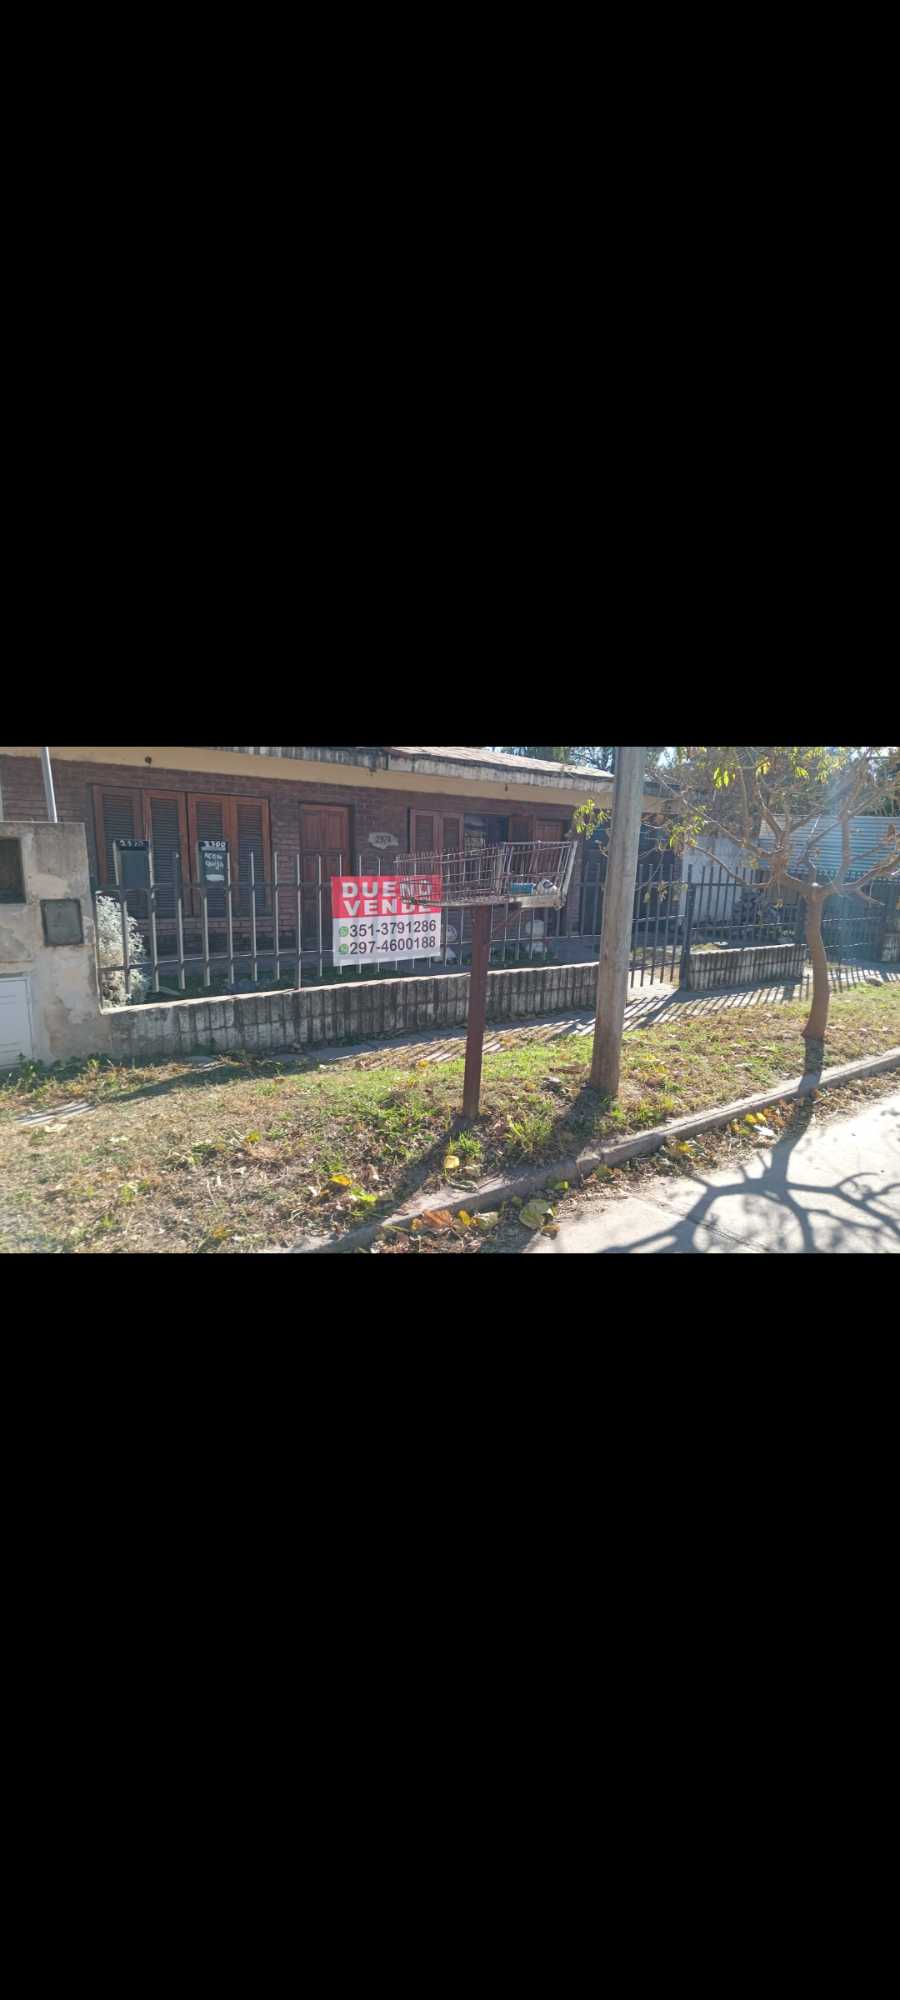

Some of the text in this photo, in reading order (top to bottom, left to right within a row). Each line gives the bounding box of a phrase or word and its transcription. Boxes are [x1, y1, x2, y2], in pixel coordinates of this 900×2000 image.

[343, 898, 432, 917] VENDE
[350, 920, 437, 938] 351-3791286
[349, 936, 436, 955] 297-4600188
